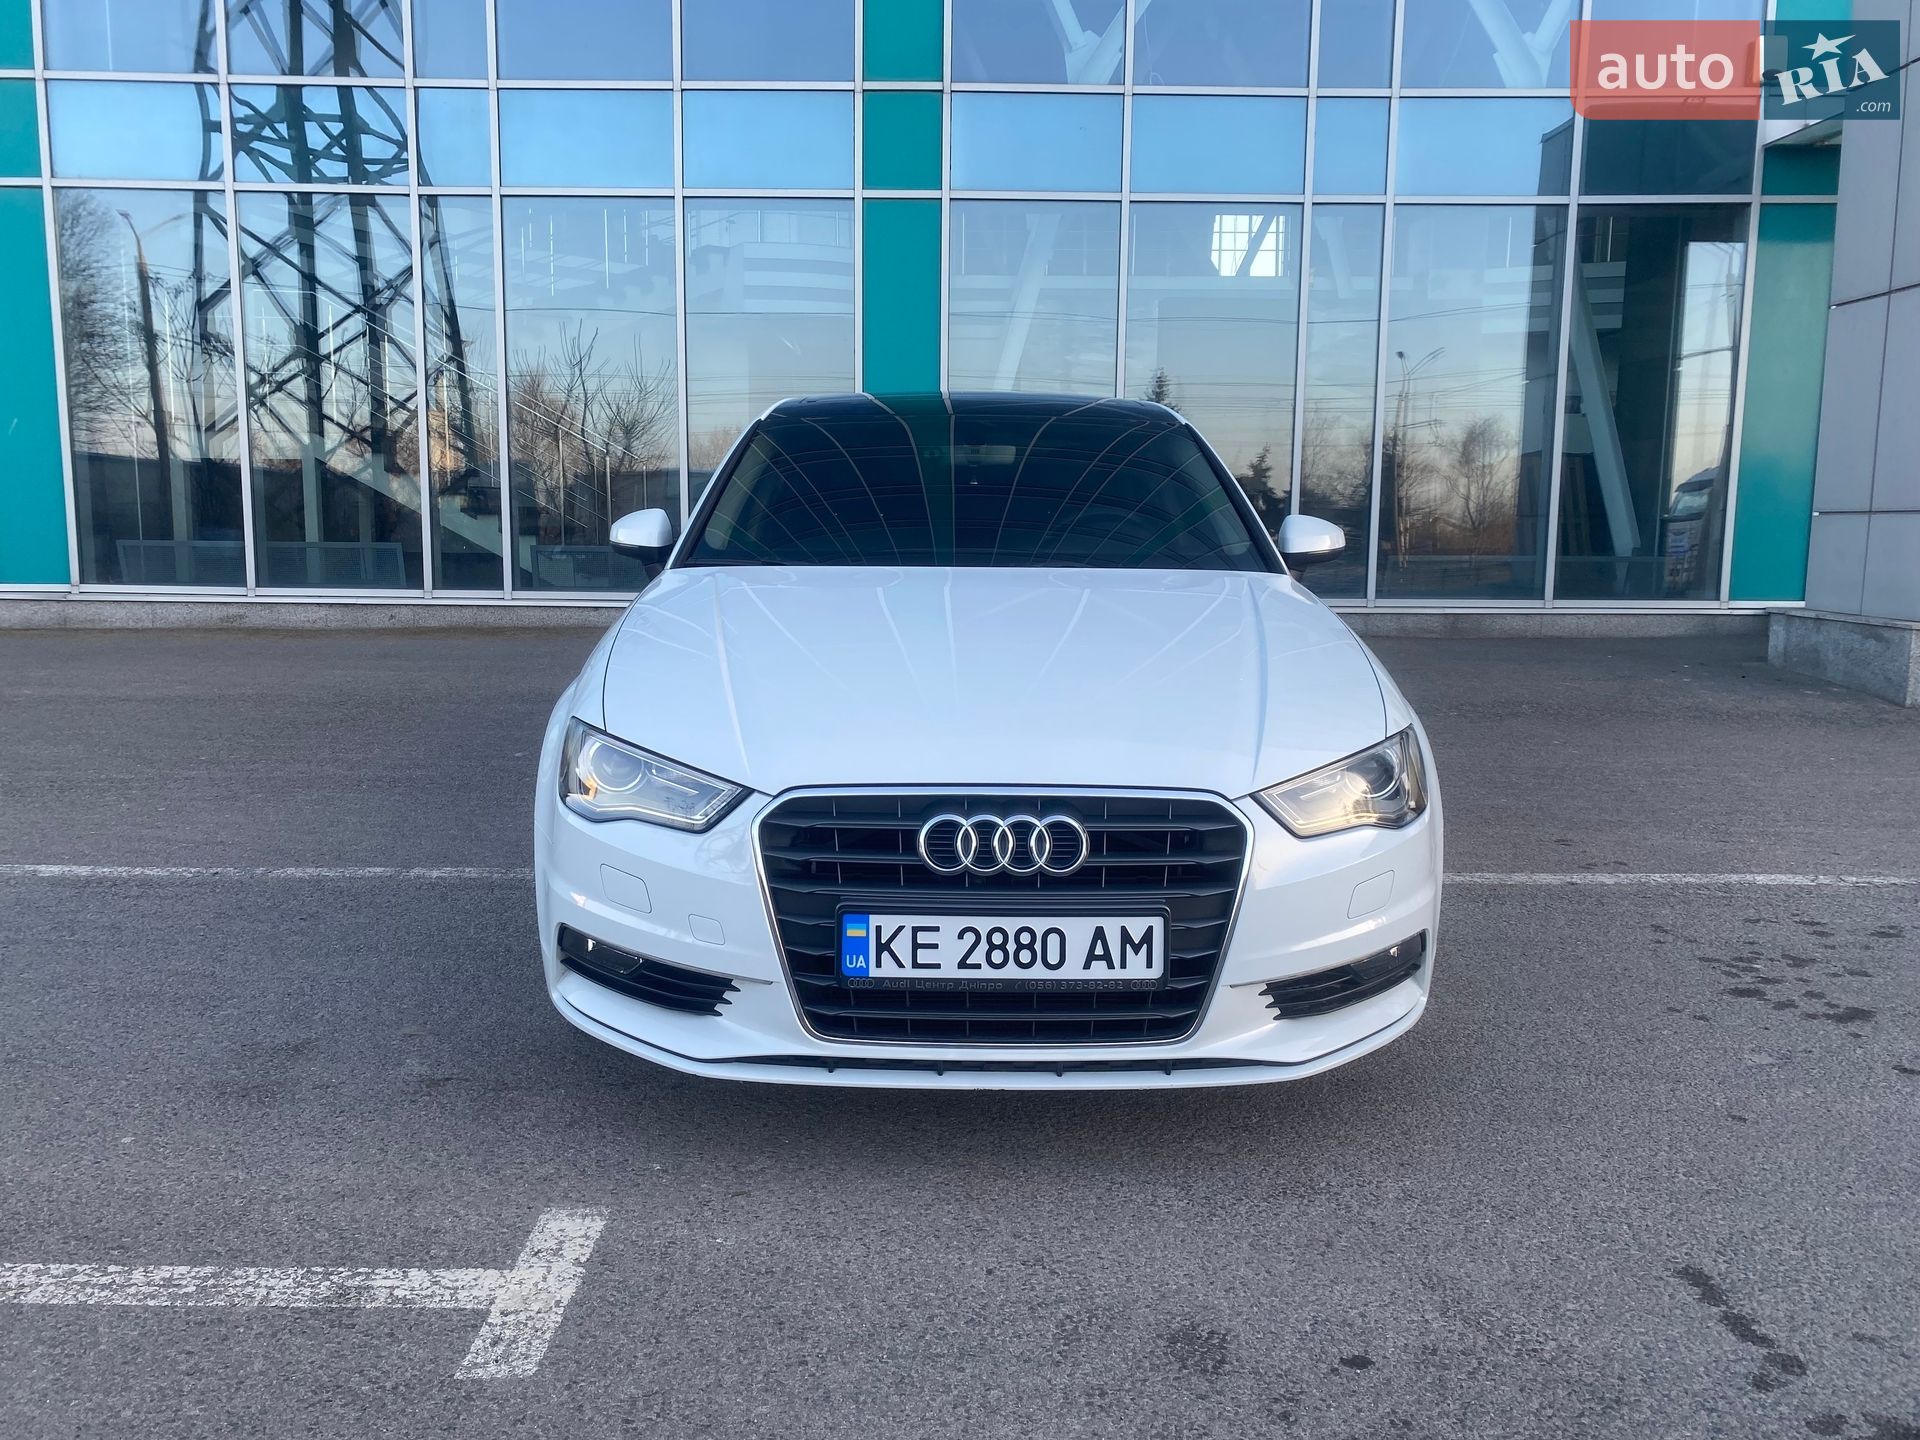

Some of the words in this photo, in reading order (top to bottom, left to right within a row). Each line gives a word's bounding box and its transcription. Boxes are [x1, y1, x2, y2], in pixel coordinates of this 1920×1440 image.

[874, 925, 942, 970] KE
[956, 925, 1067, 971] 2880
[1081, 925, 1155, 970] AM
[846, 954, 867, 969] UA
[882, 979, 910, 989] Audi
[915, 980, 954, 991] Центр
